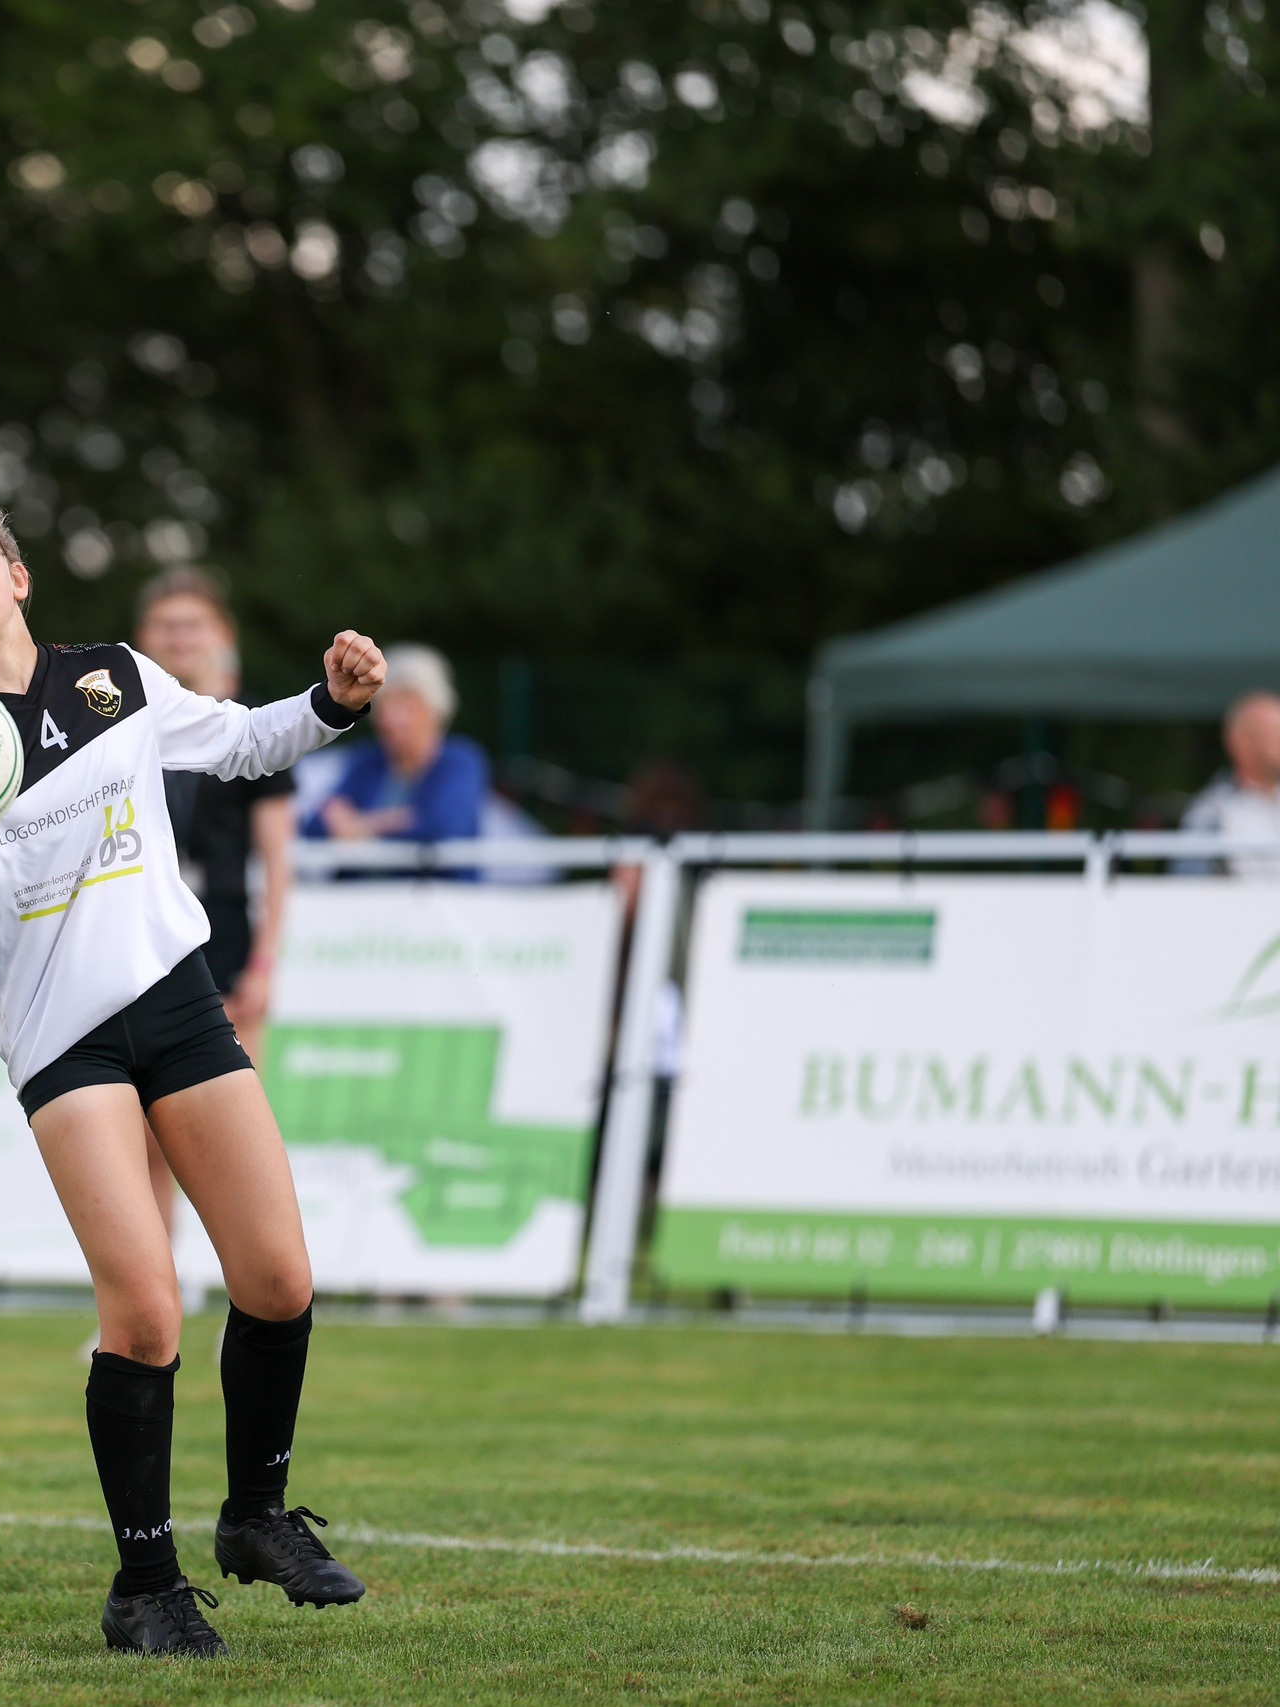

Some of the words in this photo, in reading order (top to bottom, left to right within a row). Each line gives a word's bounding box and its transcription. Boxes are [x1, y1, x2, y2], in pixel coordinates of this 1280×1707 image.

[86, 684, 114, 705] TSV
[40, 708, 69, 750] 4
[122, 1519, 171, 1540] JAKO
